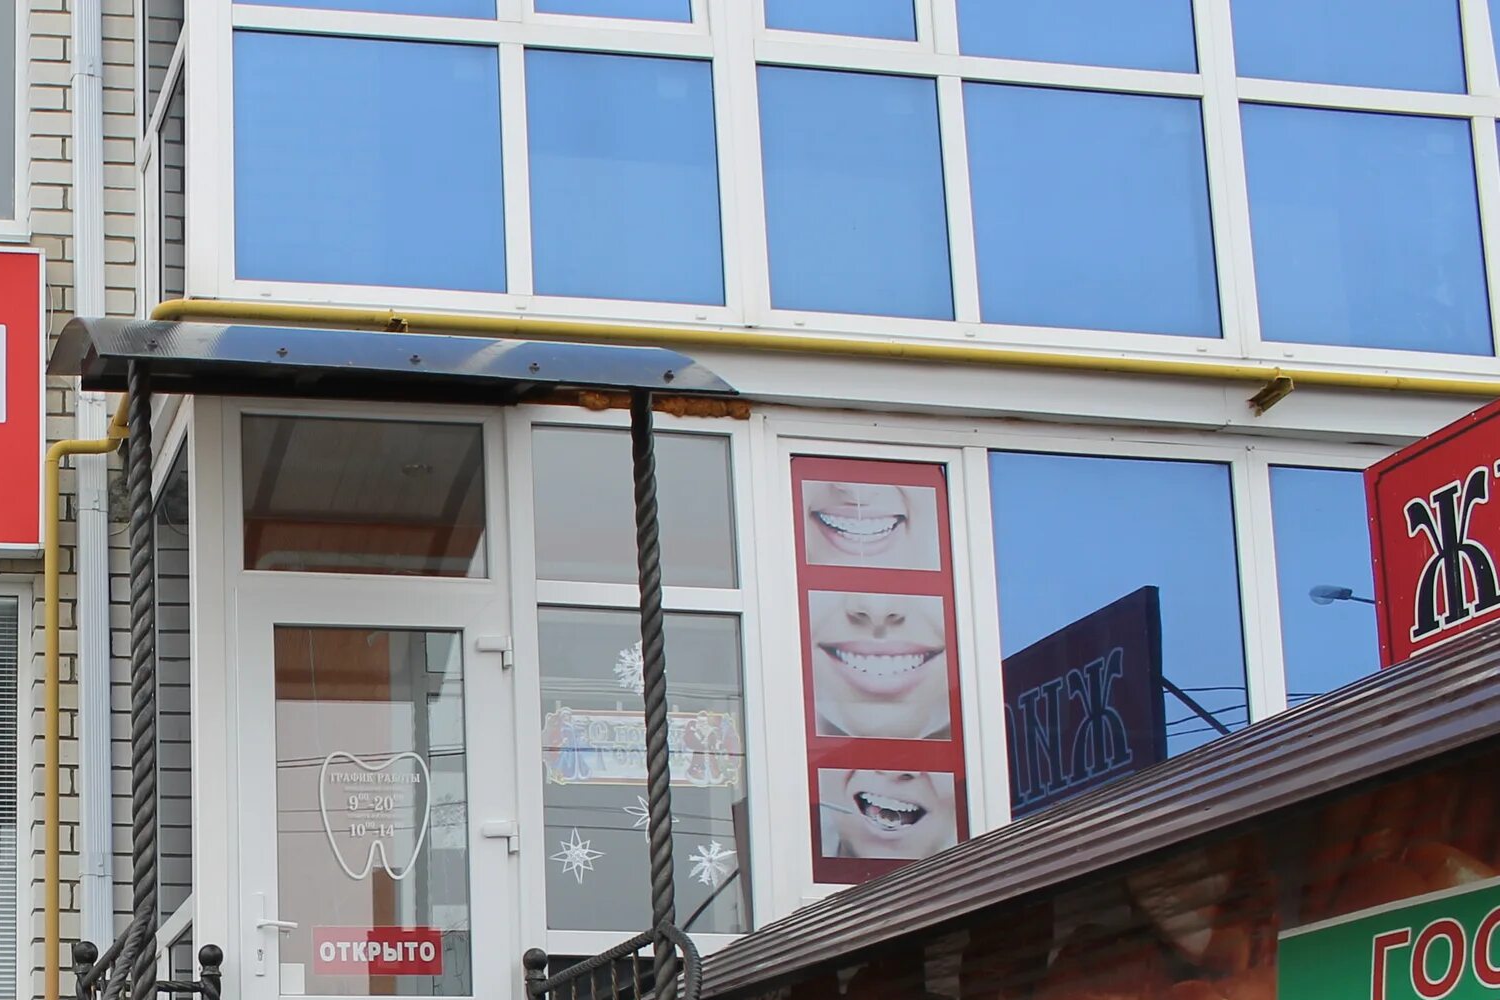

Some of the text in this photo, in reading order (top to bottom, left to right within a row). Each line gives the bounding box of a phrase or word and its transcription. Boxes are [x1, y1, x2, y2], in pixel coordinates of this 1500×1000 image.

[1403, 459, 1500, 643] Ж
[330, 772, 374, 783] ГРАФИК
[319, 940, 436, 963] ОТКРЫТО
